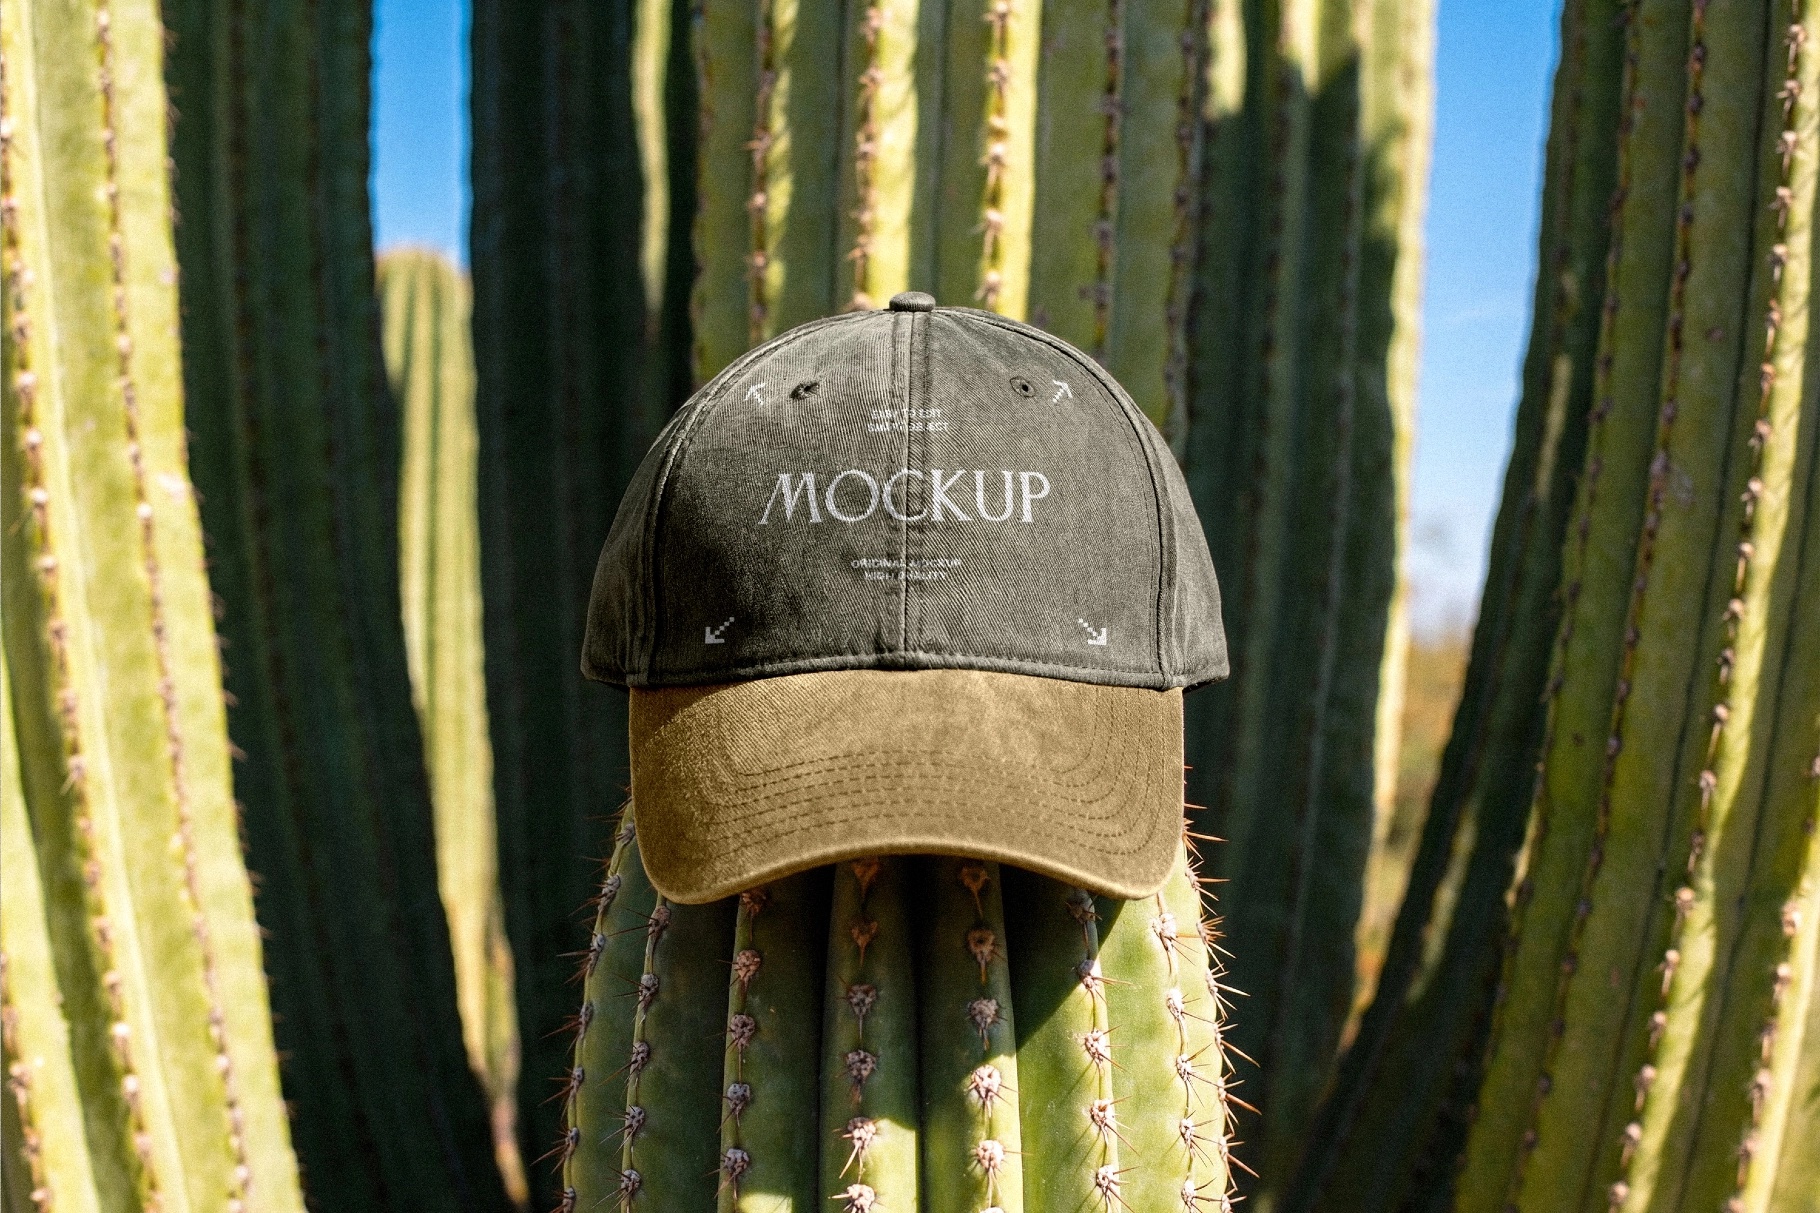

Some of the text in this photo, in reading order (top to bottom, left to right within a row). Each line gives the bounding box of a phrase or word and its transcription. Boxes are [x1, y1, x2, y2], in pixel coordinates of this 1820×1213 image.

[758, 467, 1051, 525] MOCKUP
[850, 558, 906, 569] ORIGINAL
[864, 571, 894, 581] HIGH
